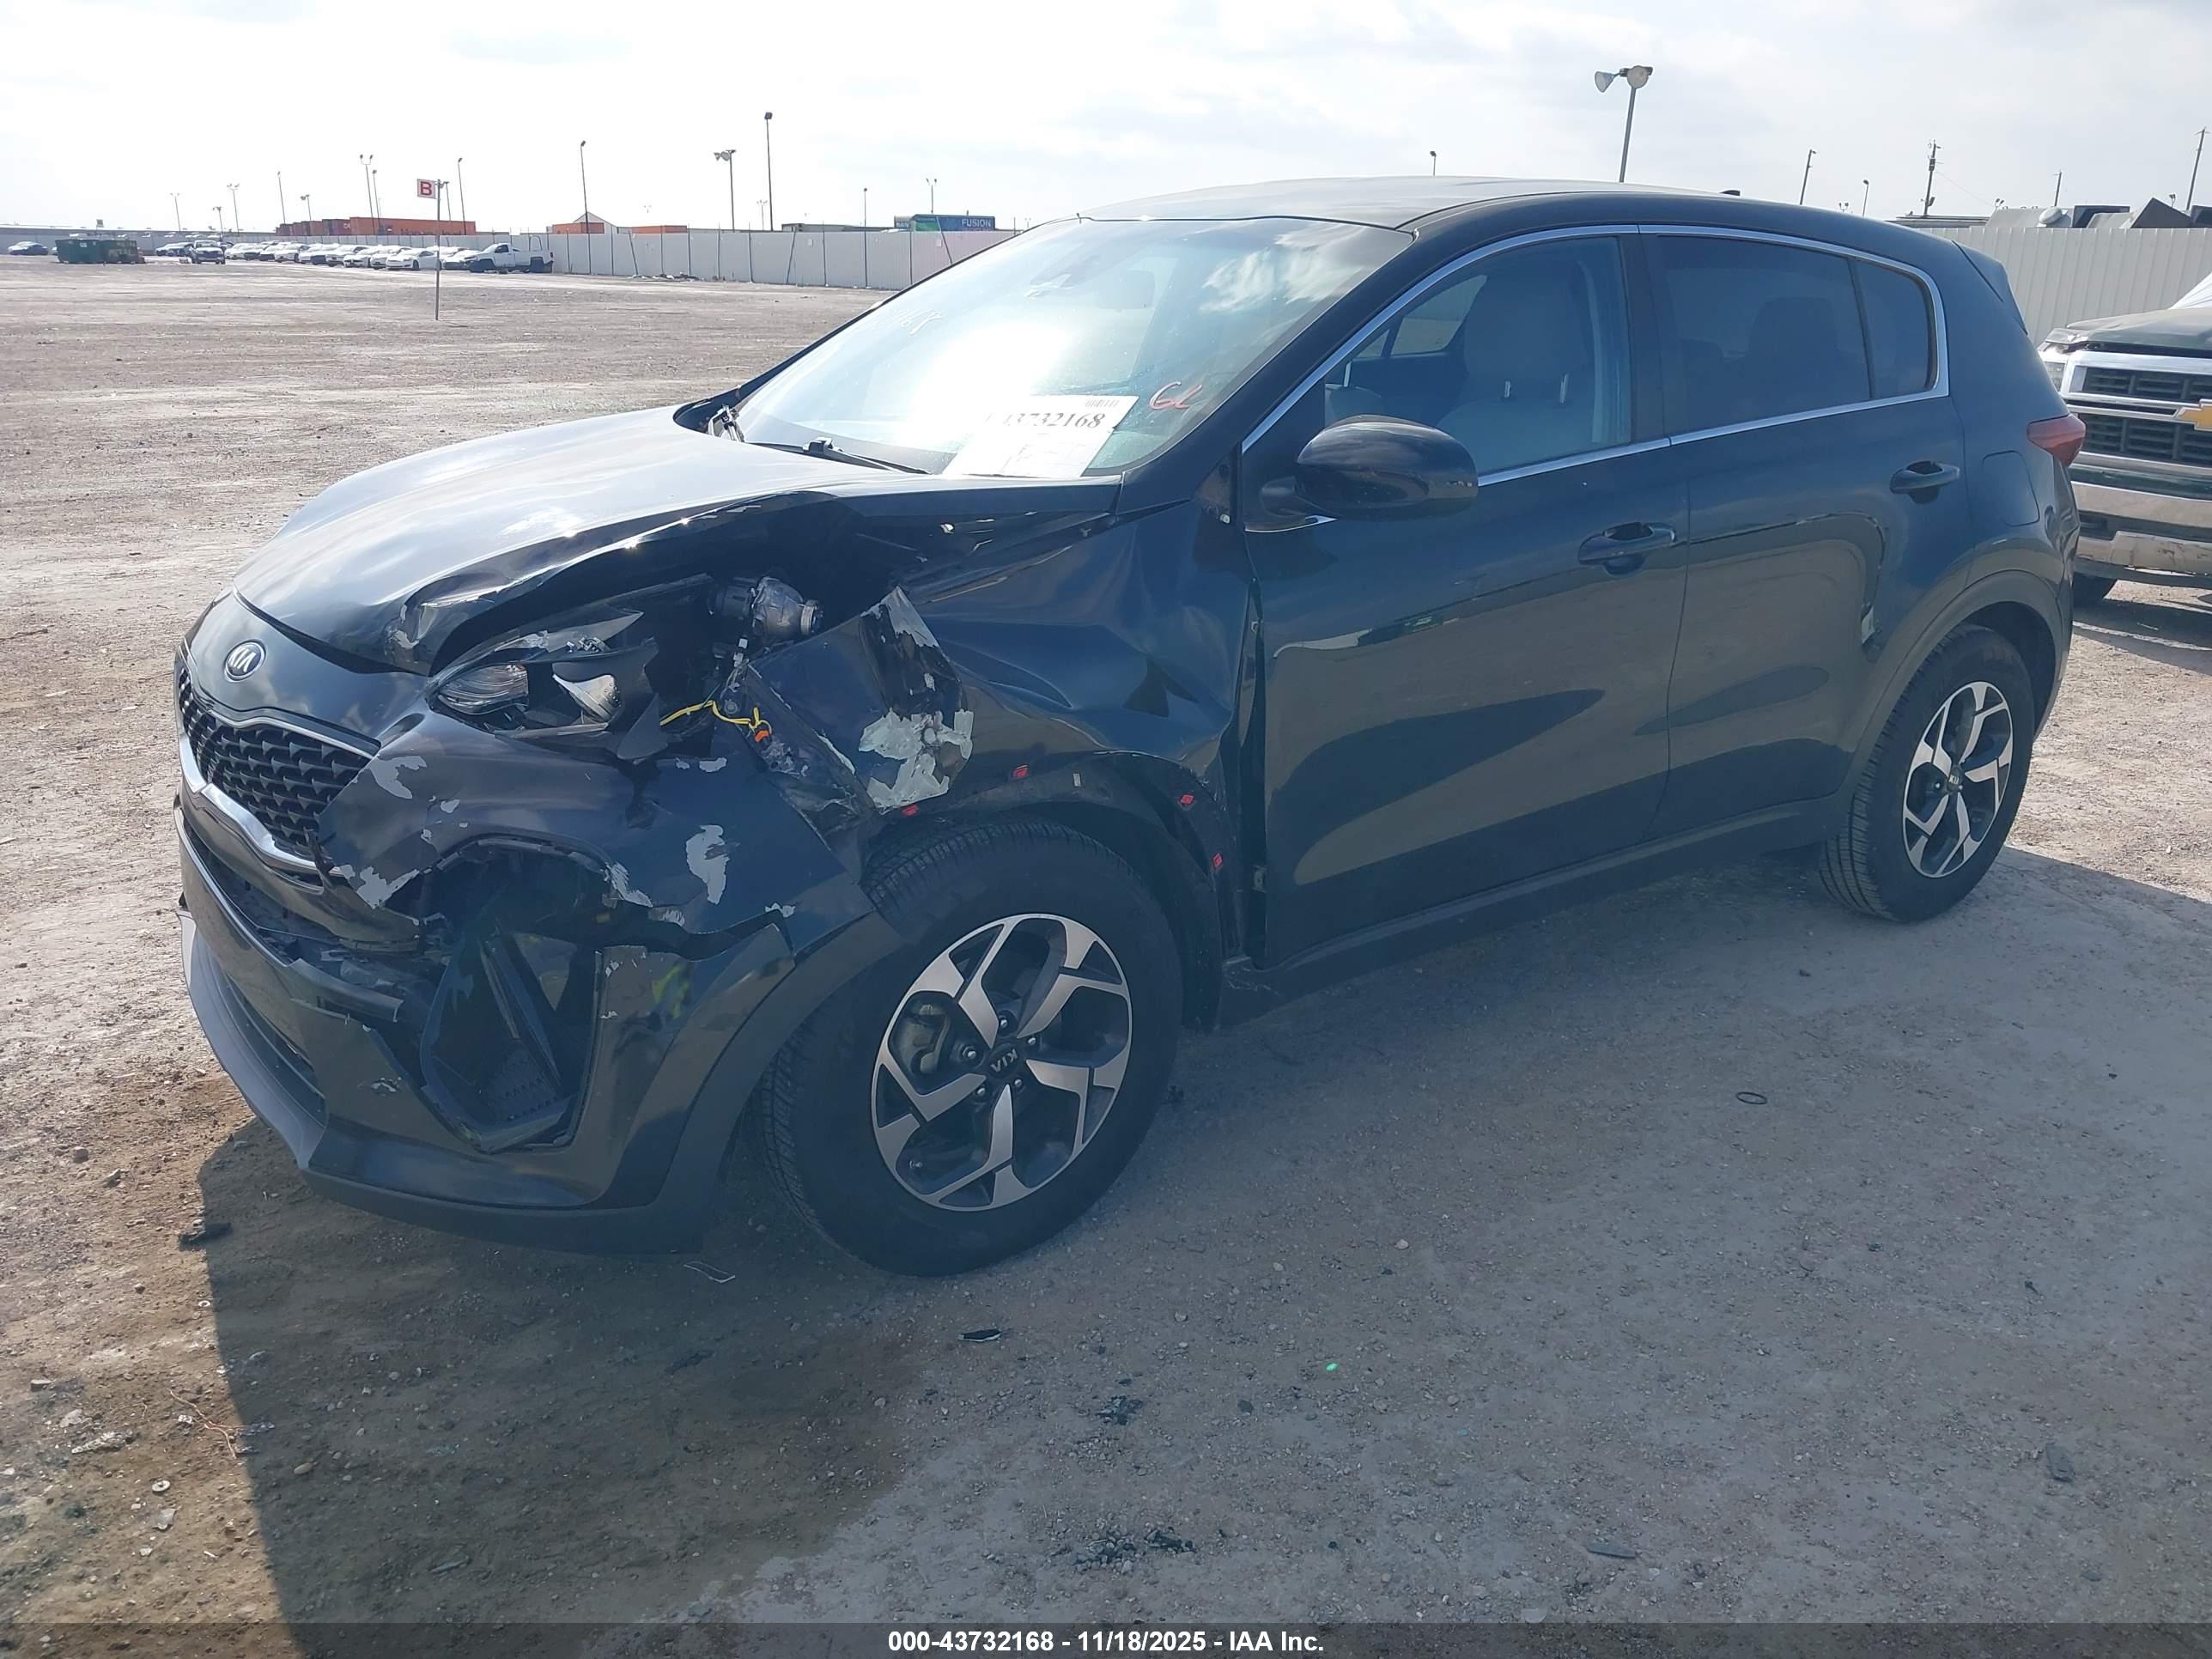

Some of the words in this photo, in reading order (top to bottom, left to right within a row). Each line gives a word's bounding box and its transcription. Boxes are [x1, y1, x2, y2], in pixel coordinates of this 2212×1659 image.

[420, 180, 433, 196] B
[961, 217, 992, 228] FUSION
[227, 646, 257, 672] KIA
[990, 1048, 1018, 1073] KIA
